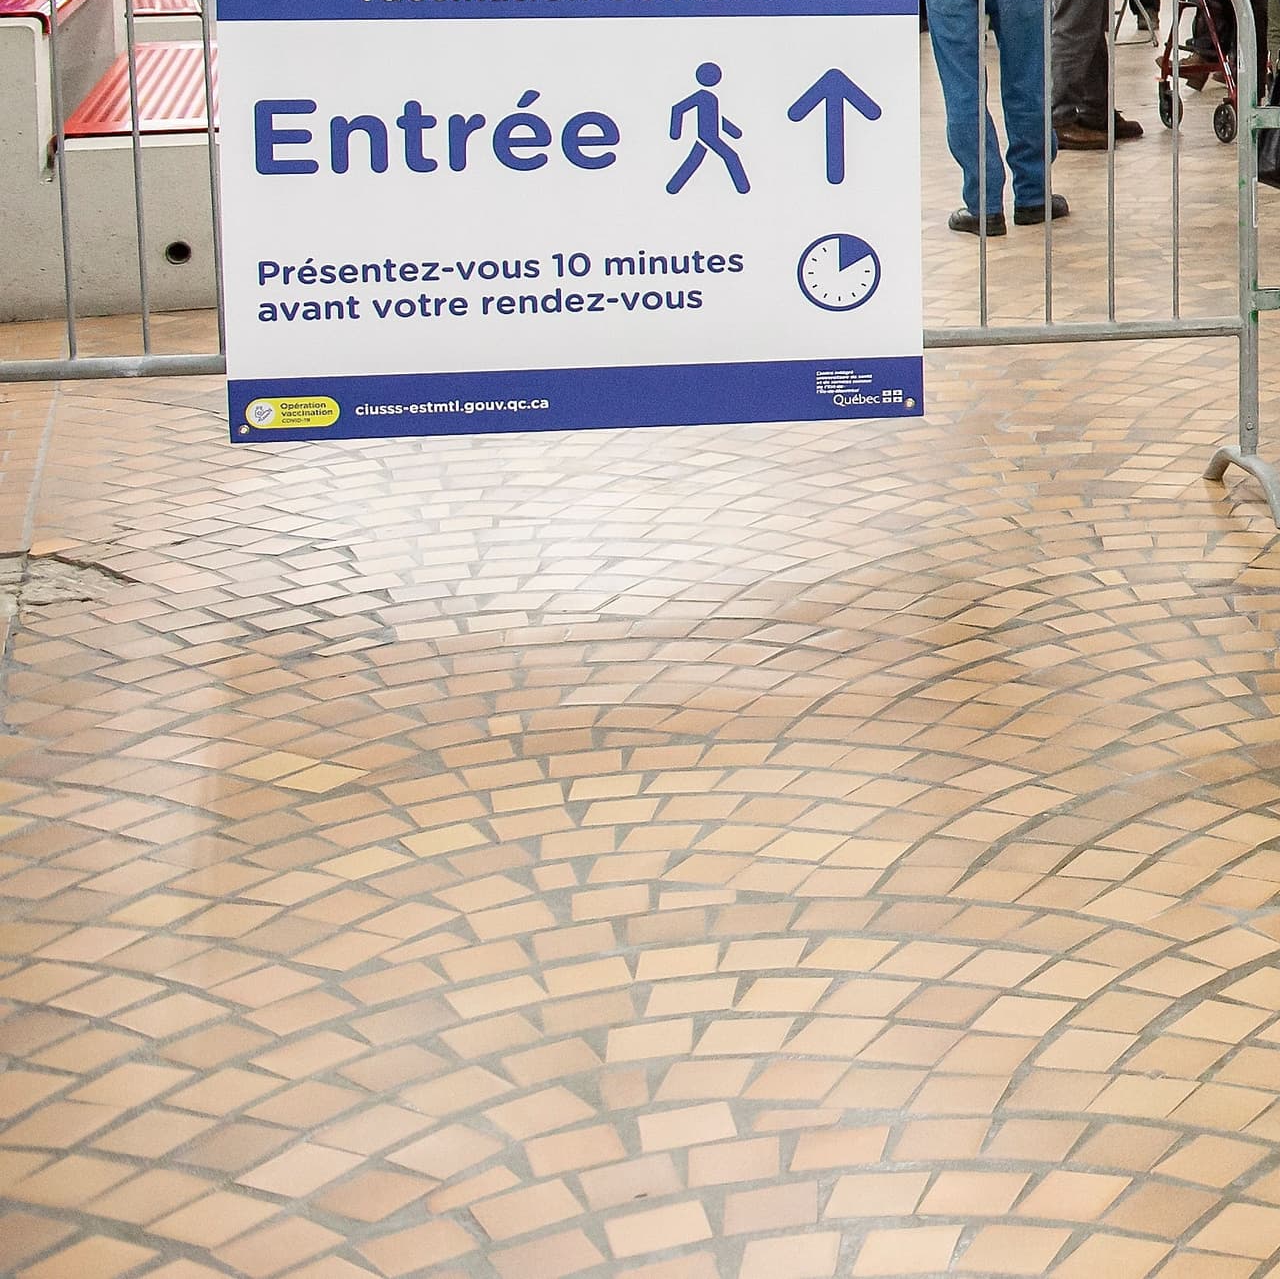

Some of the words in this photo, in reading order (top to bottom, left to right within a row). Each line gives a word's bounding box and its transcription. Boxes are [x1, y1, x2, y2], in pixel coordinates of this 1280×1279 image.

[254, 89, 620, 175] Entrée
[256, 257, 541, 286] Présentez-vous
[551, 252, 591, 278] 10
[604, 250, 745, 276] minutes
[257, 295, 360, 322] avant
[372, 292, 468, 319] votre
[482, 286, 704, 315] rendez-vous
[355, 398, 550, 416] ciusss-estmtl.gouv.qc.ca
[833, 394, 880, 406] Québec
